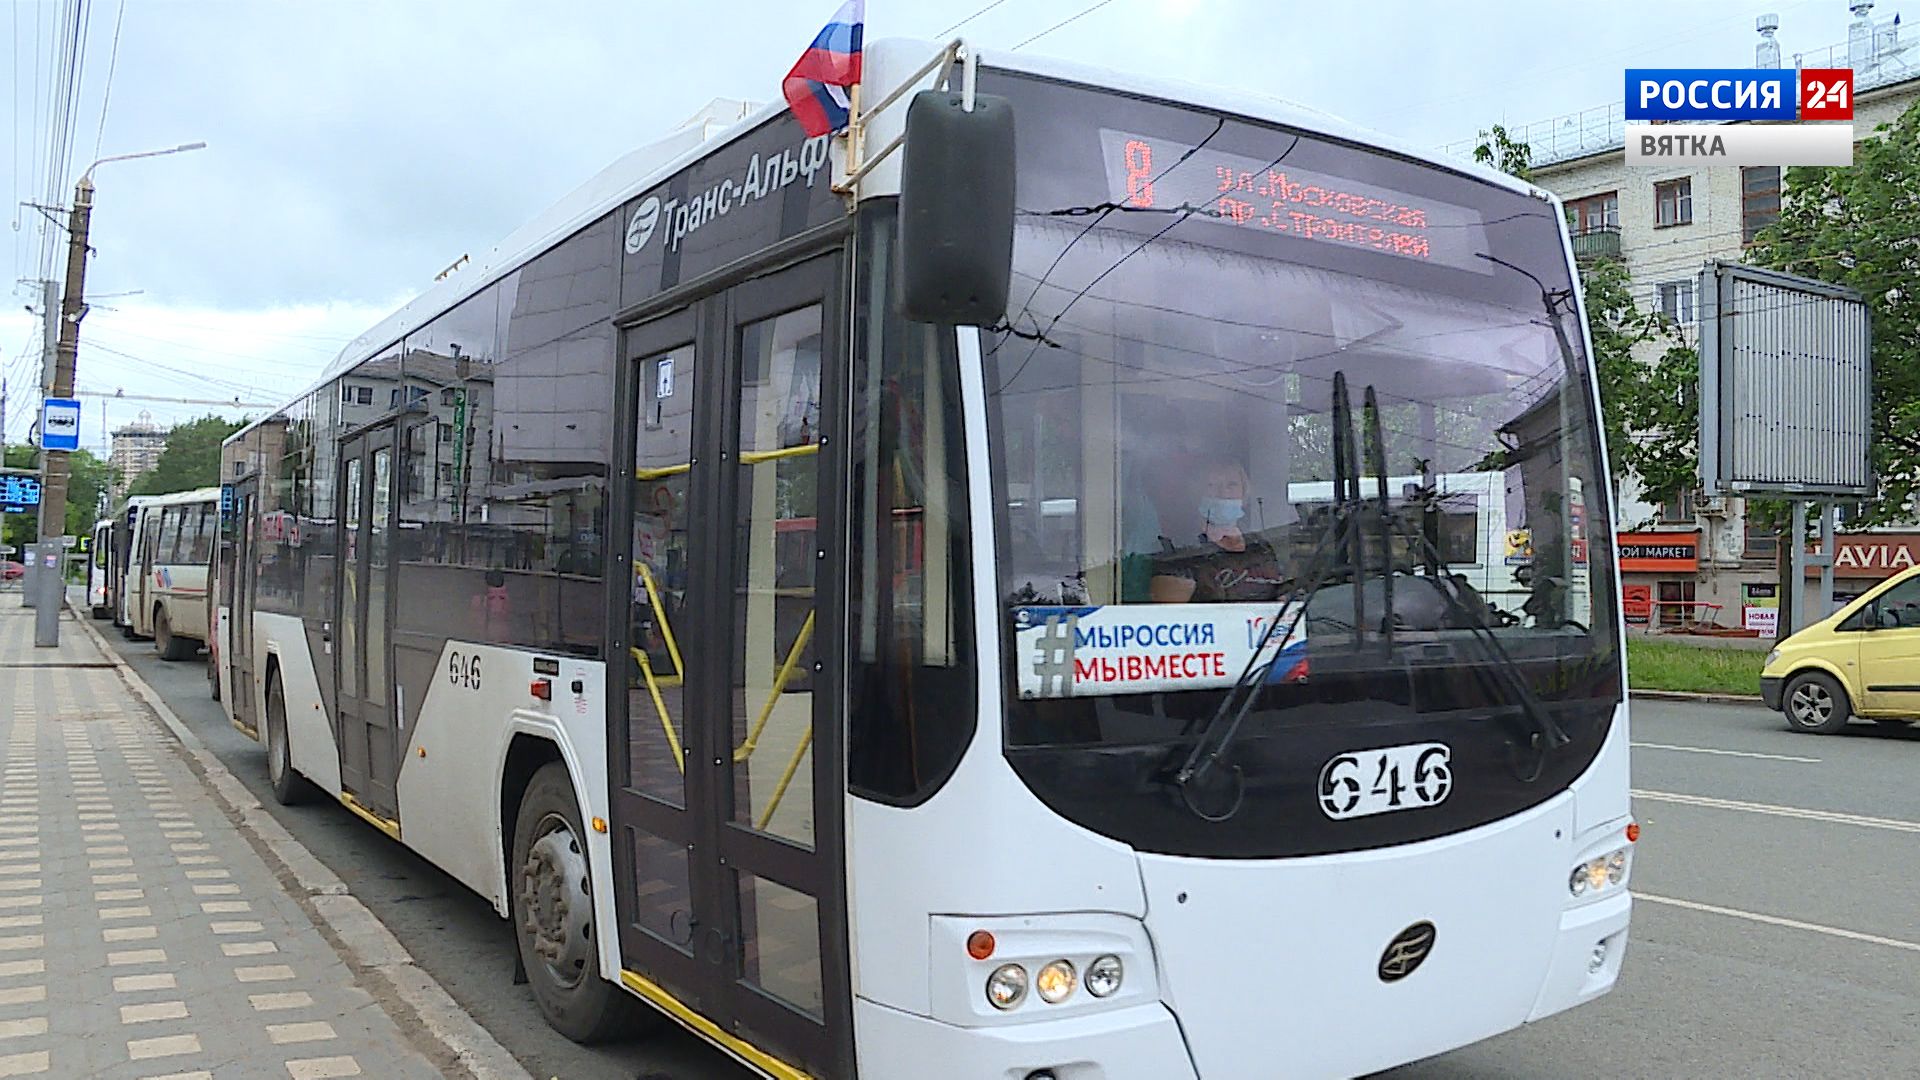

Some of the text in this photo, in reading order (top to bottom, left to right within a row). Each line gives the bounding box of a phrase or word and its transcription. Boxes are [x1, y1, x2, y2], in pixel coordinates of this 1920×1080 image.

[664, 136, 838, 252] Транс-Альф
[1124, 140, 1153, 208] 8
[1645, 547, 1687, 558] МАРКЕТ
[450, 651, 481, 690] 646
[1322, 747, 1447, 814] 646
